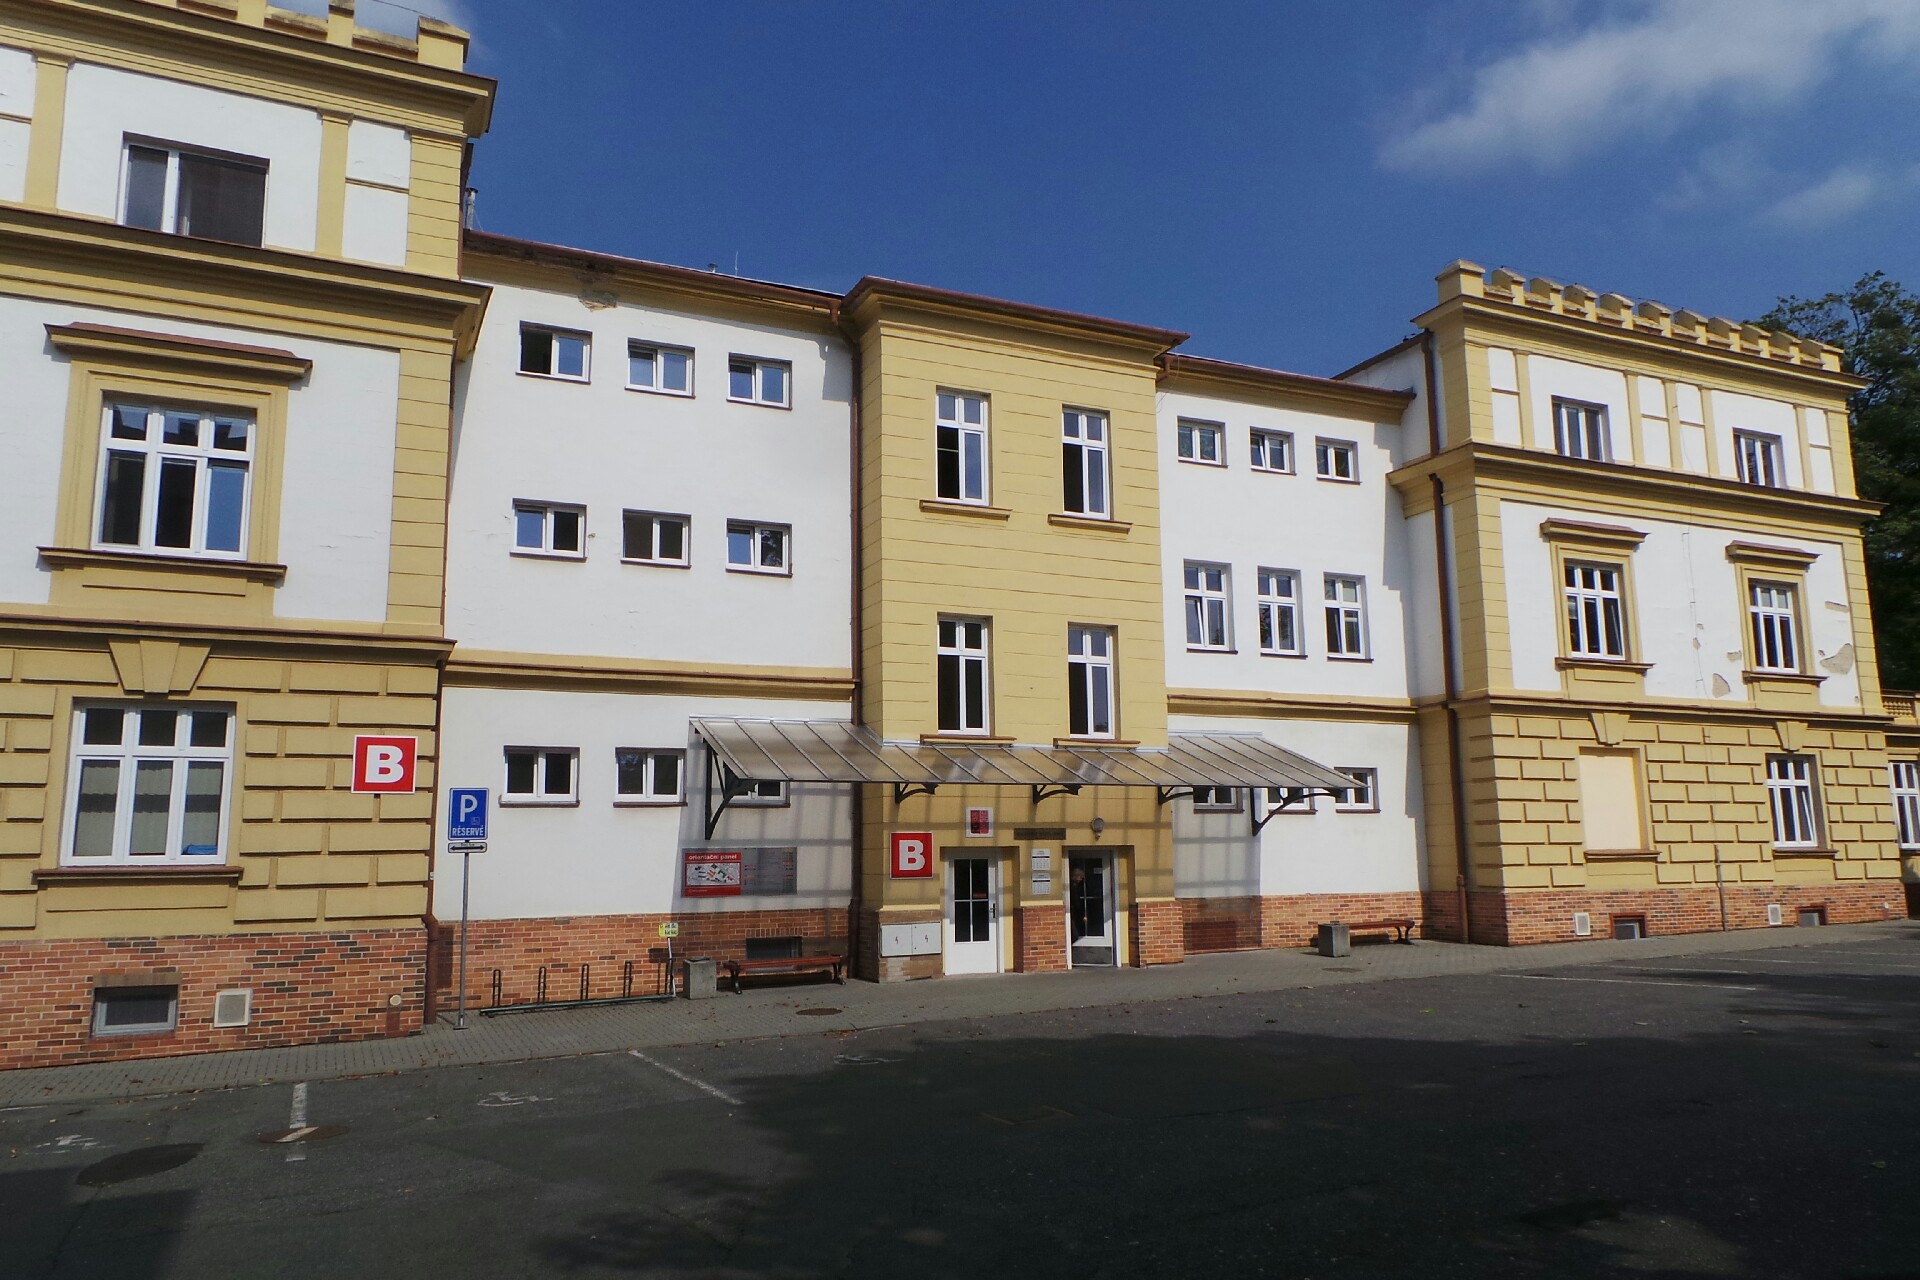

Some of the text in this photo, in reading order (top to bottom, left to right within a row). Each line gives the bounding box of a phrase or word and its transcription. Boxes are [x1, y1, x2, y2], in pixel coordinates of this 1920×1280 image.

[365, 745, 404, 784] B
[460, 794, 478, 823] P
[452, 825, 484, 836] RÉSERVÉ
[899, 840, 926, 871] B
